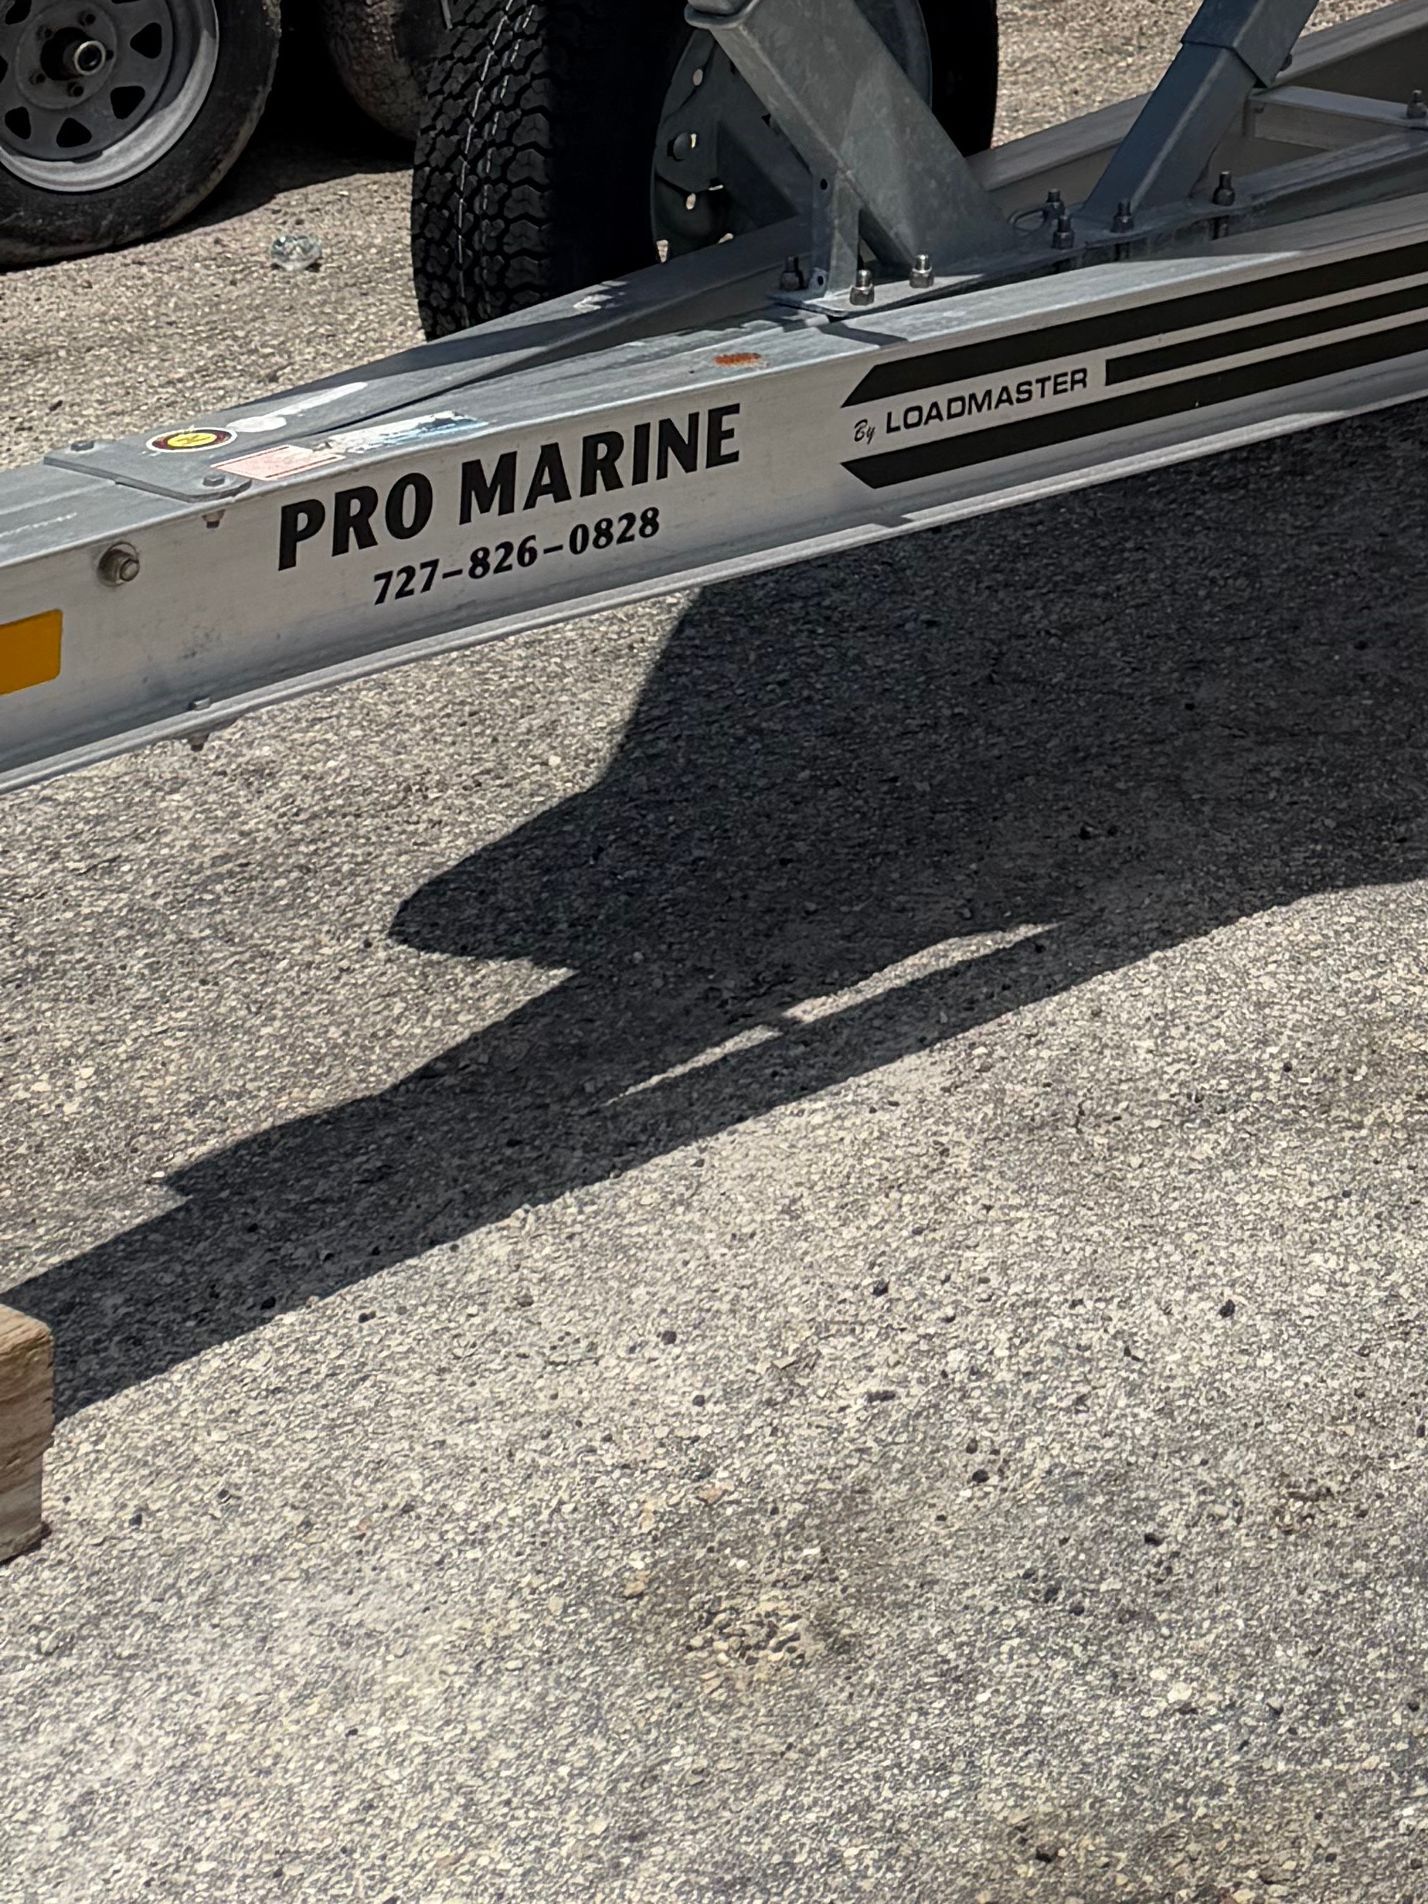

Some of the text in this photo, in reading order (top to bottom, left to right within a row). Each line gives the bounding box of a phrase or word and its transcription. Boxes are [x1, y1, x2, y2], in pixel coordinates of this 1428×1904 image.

[854, 367, 1088, 444] By LOADMASTER
[278, 403, 741, 571] PRO MARINE
[373, 507, 661, 605] 727-826-0828
